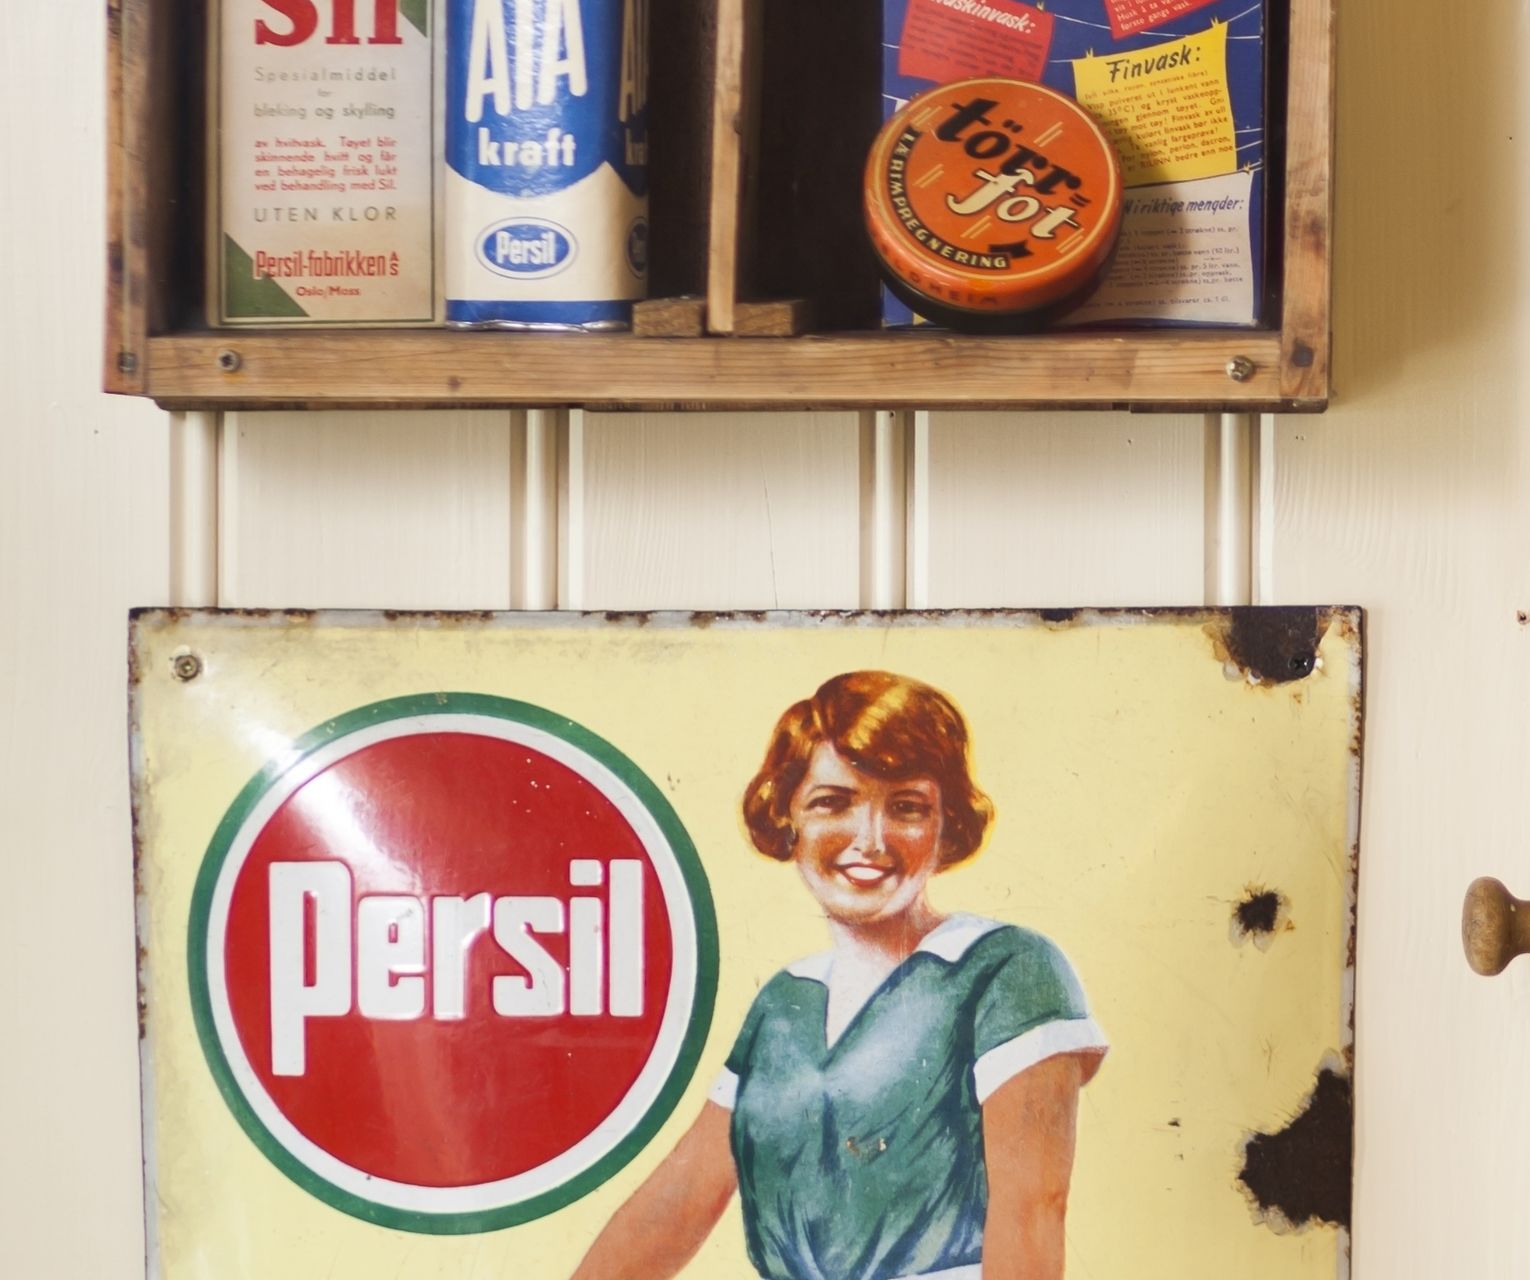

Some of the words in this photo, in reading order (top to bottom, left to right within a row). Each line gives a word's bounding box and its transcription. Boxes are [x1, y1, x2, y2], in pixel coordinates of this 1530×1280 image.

[1105, 43, 1202, 84] Finvask:
[253, 66, 397, 83] Spesialmiddel
[253, 102, 307, 120] bleking
[314, 106, 335, 120] og
[342, 102, 396, 120] skylling
[377, 136, 397, 148] blir
[478, 128, 577, 168] kraft
[255, 151, 315, 162] skinnende
[358, 154, 373, 164] og
[277, 166, 336, 178] behagelig
[374, 165, 398, 176] lukt
[255, 180, 277, 191] ved
[280, 179, 347, 192] behandling
[350, 179, 376, 190] med
[945, 168, 1081, 240] fot
[253, 206, 319, 223] UTEN
[331, 206, 398, 222] KLOR
[496, 231, 558, 266] Persil
[255, 250, 387, 280] Persil-fabrikken
[295, 284, 362, 299] Oslo/Moss
[267, 857, 645, 1077] Persil
